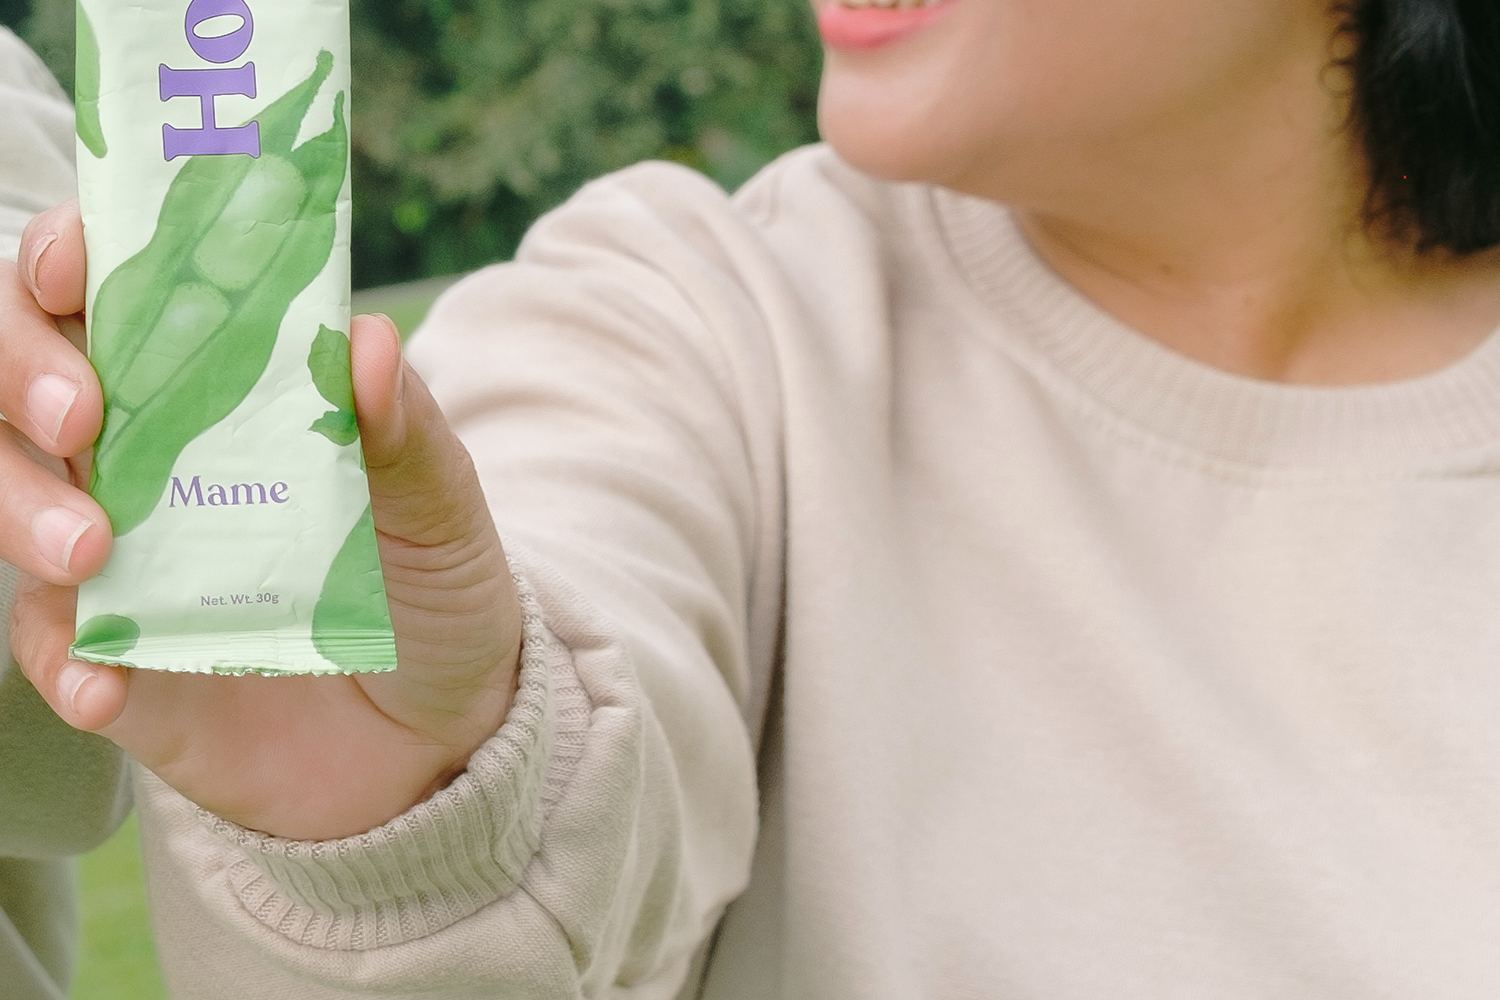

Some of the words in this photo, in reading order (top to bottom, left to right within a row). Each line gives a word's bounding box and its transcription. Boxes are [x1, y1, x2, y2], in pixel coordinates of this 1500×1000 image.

[169, 475, 290, 508] Mame
[200, 594, 228, 607] Net.
[230, 592, 253, 605] Wt.
[256, 592, 280, 605] 30g
